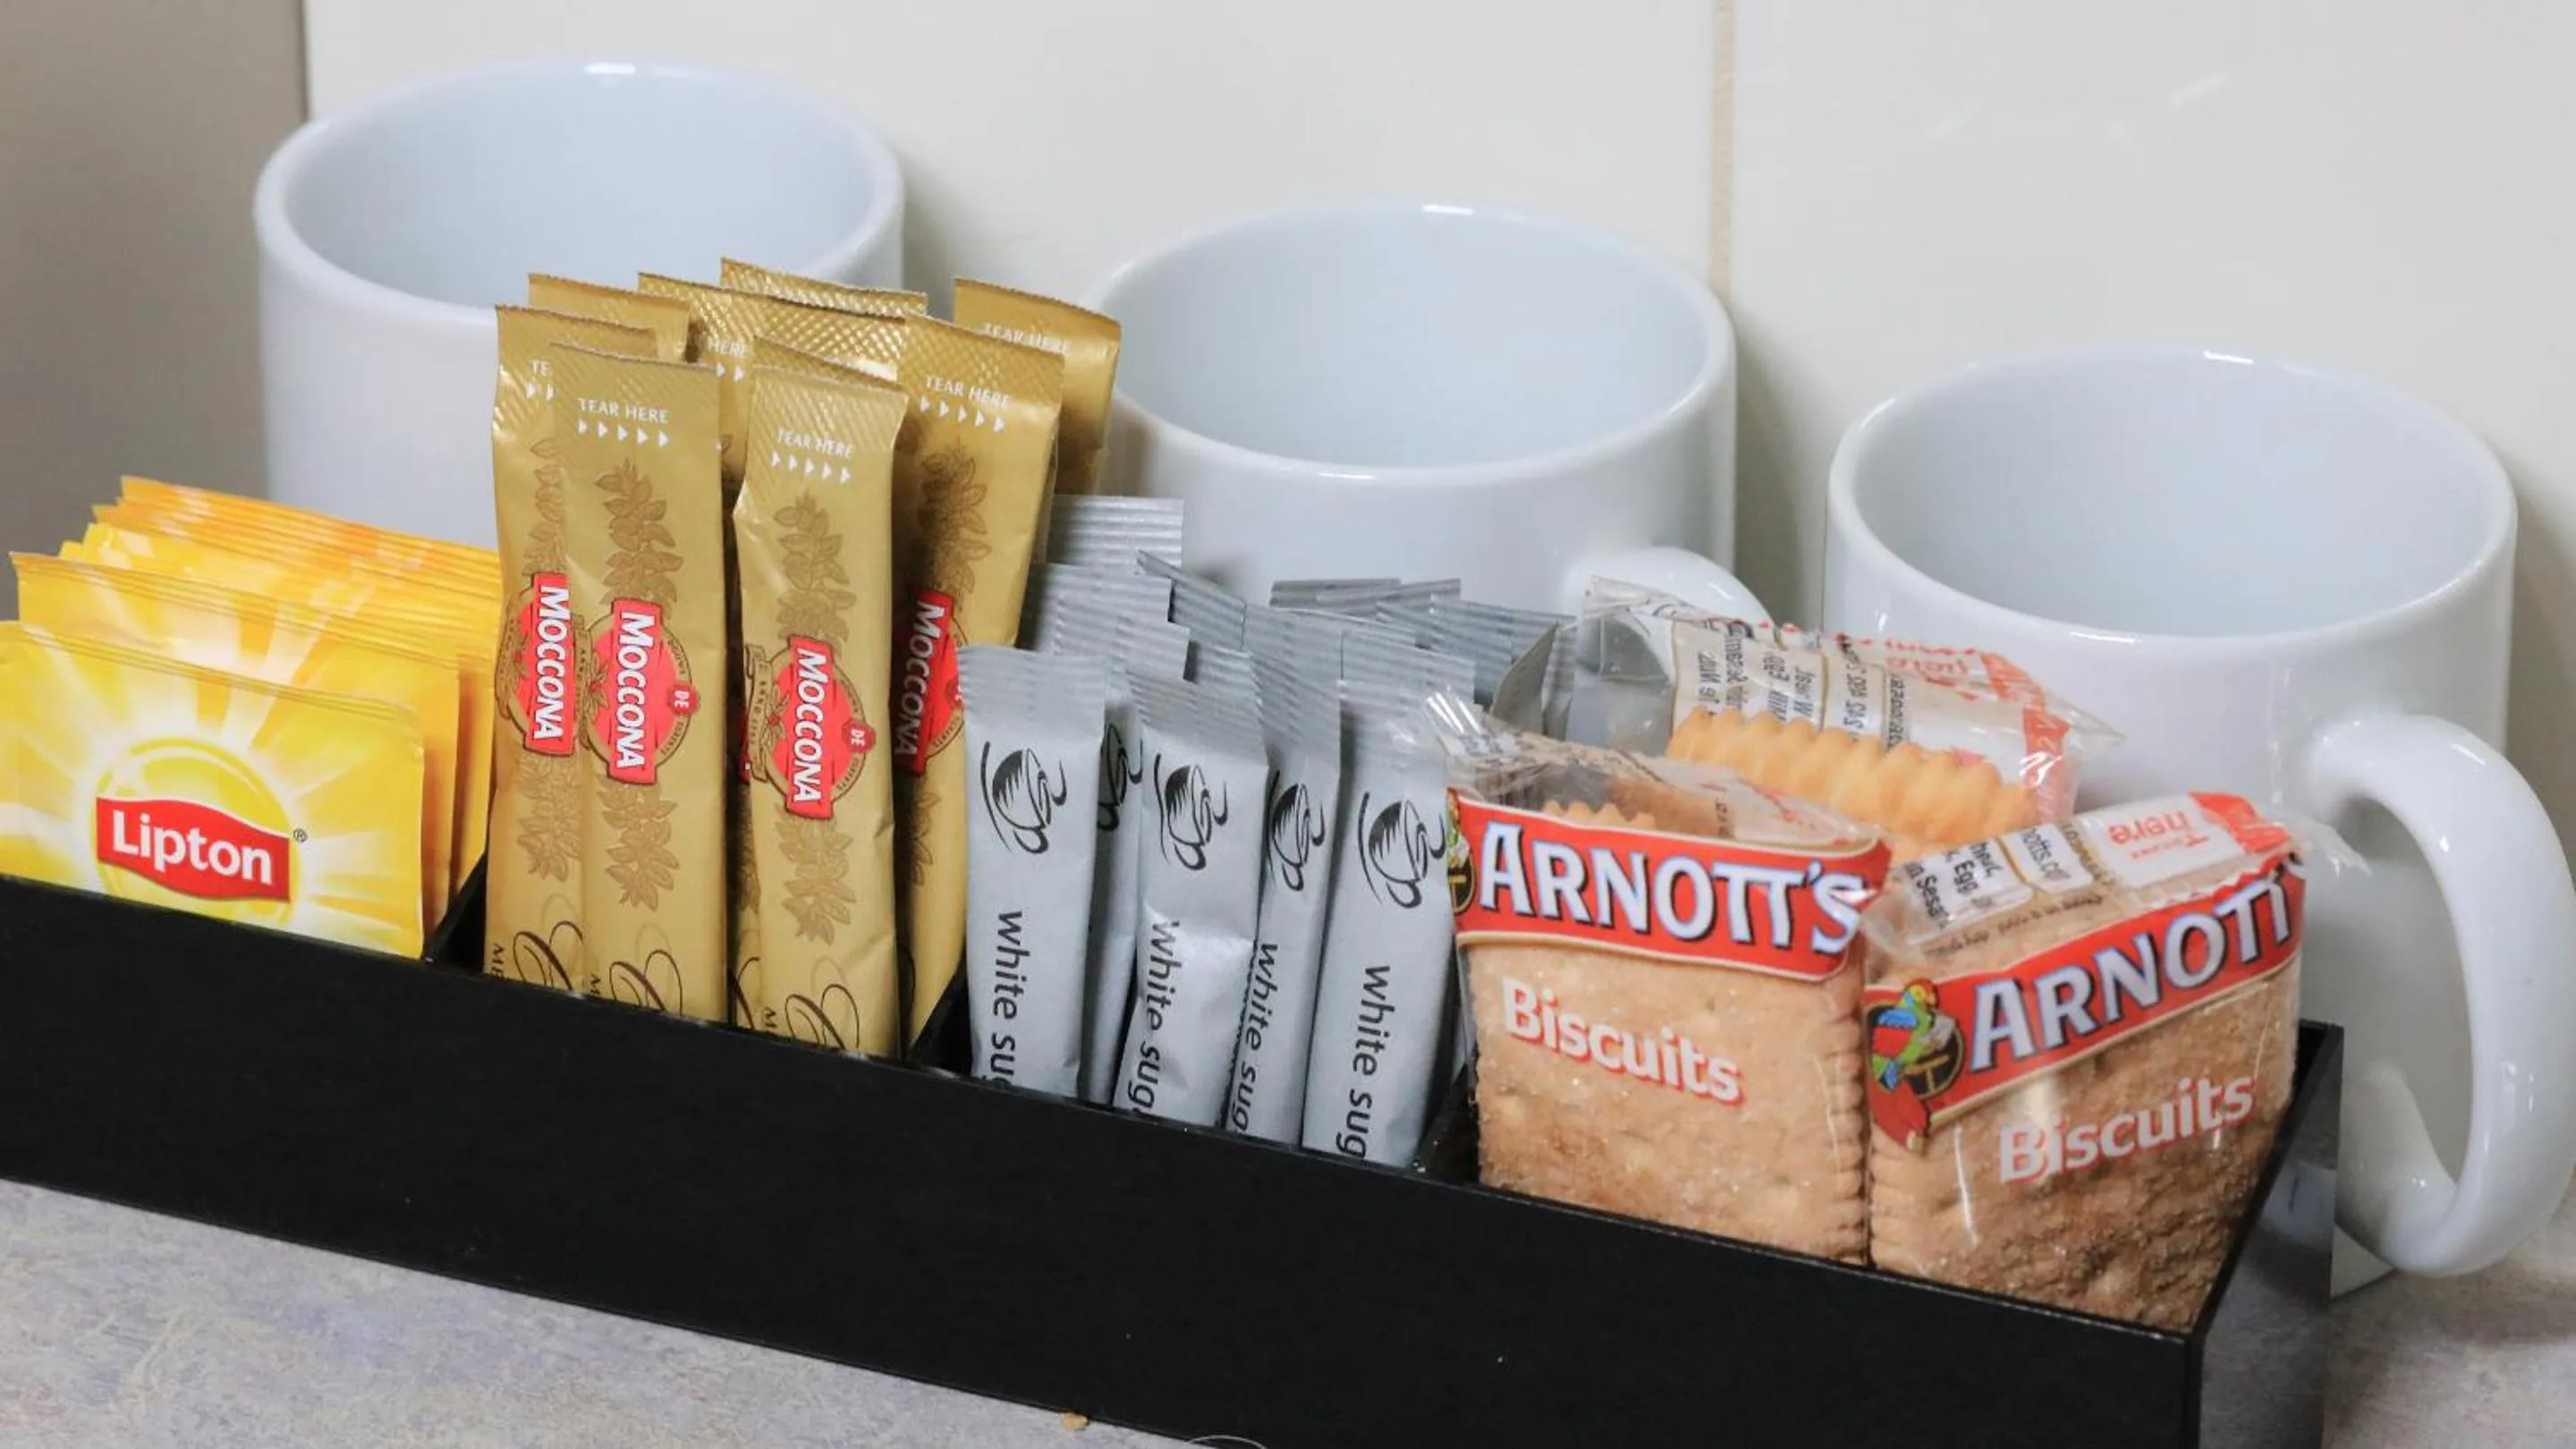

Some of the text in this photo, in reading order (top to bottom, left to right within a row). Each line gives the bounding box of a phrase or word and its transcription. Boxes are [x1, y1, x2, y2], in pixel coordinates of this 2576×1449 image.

[531, 360, 551, 377] TE
[578, 398, 669, 424] TEAR HERE
[925, 377, 1011, 409] TEAR HERE
[776, 430, 854, 459] TEAR HERE
[534, 585, 571, 740] MOCCONA
[615, 612, 655, 768] MOCCONA
[674, 690, 691, 709] DE
[894, 601, 945, 755] MOCCONA
[794, 648, 829, 802] MOCCONA
[850, 728, 867, 747] DE
[112, 809, 273, 886] Lipton
[1479, 820, 1868, 954] ARNOTT'S
[993, 911, 1030, 1020] white
[1147, 920, 1182, 1031] white
[1245, 943, 1278, 1051] white
[1970, 866, 2303, 1072] ARNOTT
[1352, 965, 1395, 1076] white
[1502, 976, 1743, 1106] Biscuits
[1999, 1076, 2256, 1182] Biscuits
